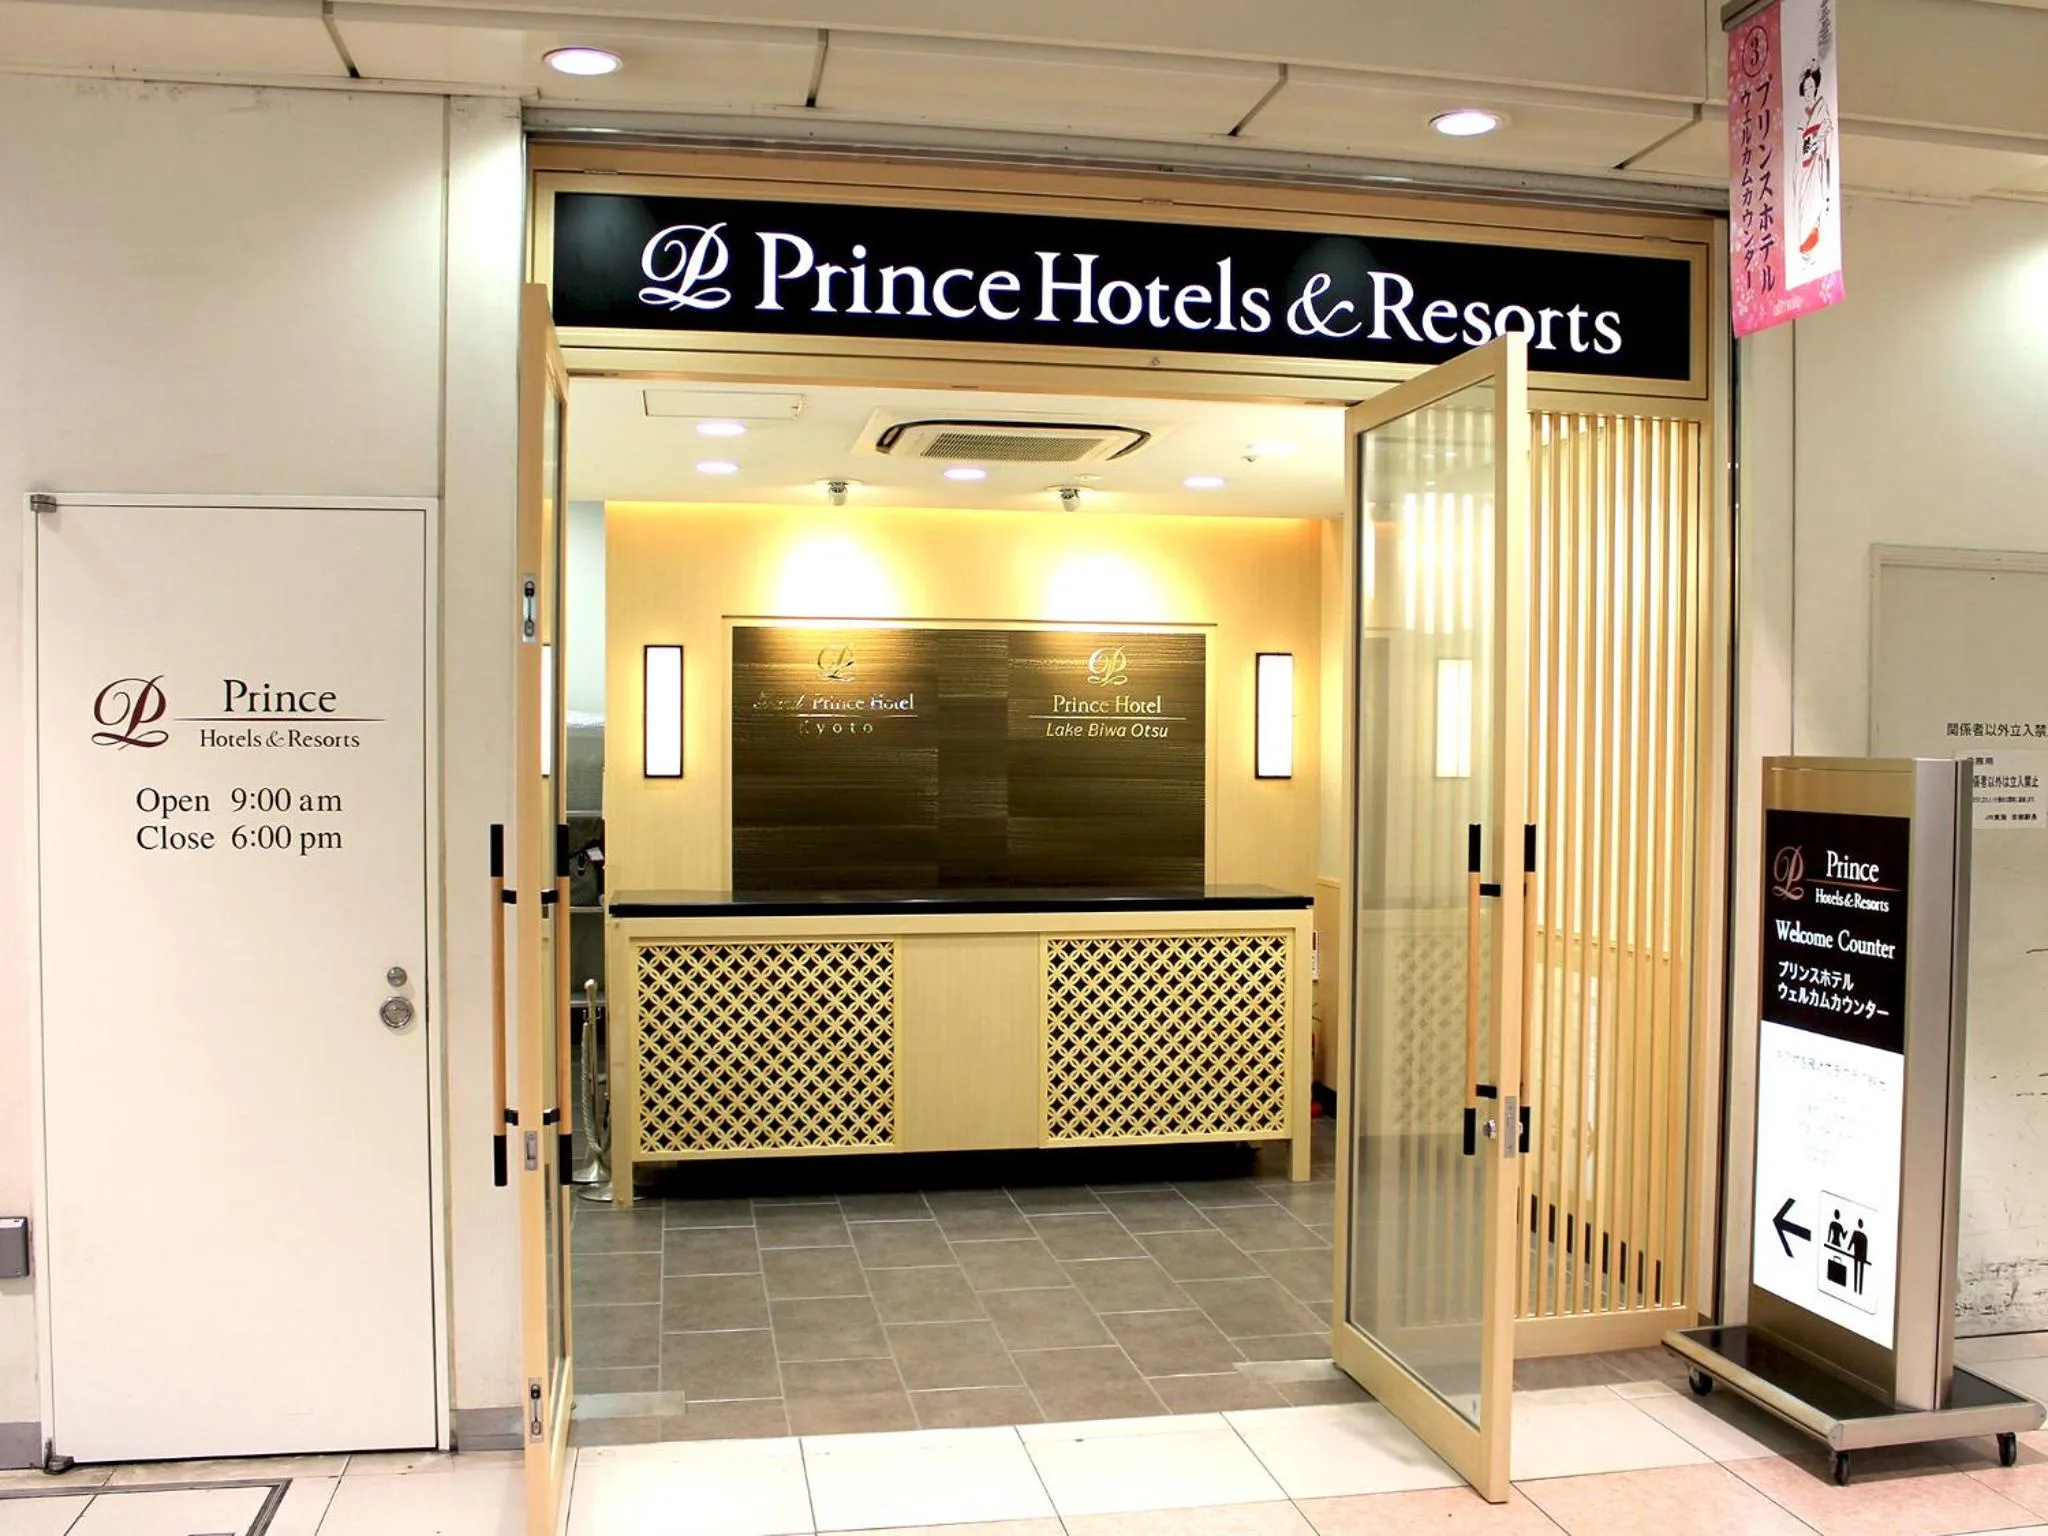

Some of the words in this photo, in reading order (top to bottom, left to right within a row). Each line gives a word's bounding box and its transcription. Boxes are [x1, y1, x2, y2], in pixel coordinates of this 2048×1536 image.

[1756, 73, 1776, 296] プリンスホテル
[755, 231, 1021, 320] Prince
[1035, 251, 1271, 333] Hotels
[1367, 271, 1622, 357] Resorts
[223, 679, 337, 713] Prince
[812, 693, 864, 710] Prince
[870, 692, 915, 710] Hotel
[1052, 694, 1111, 713] Prince
[1115, 694, 1162, 713] Hotel
[200, 729, 262, 748] Hotels
[288, 730, 360, 748] Resorts
[1046, 722, 1084, 737] Lake
[1088, 722, 1127, 737] Biwa
[1131, 722, 1169, 738] Otsu
[1946, 722, 2048, 738] 関係者以外立入禁
[136, 787, 210, 819] Open
[231, 787, 292, 812] 9:00
[299, 794, 343, 812] am
[136, 825, 215, 850] Close
[231, 824, 292, 850] 6:00
[300, 831, 343, 857] pm
[1826, 850, 1880, 883] Prince
[1775, 918, 1834, 949] Welcome
[1838, 929, 1896, 960] Counter
[1778, 960, 1854, 991] プリンスホテル
[1777, 981, 1890, 1020] ウェルカムカウンター
